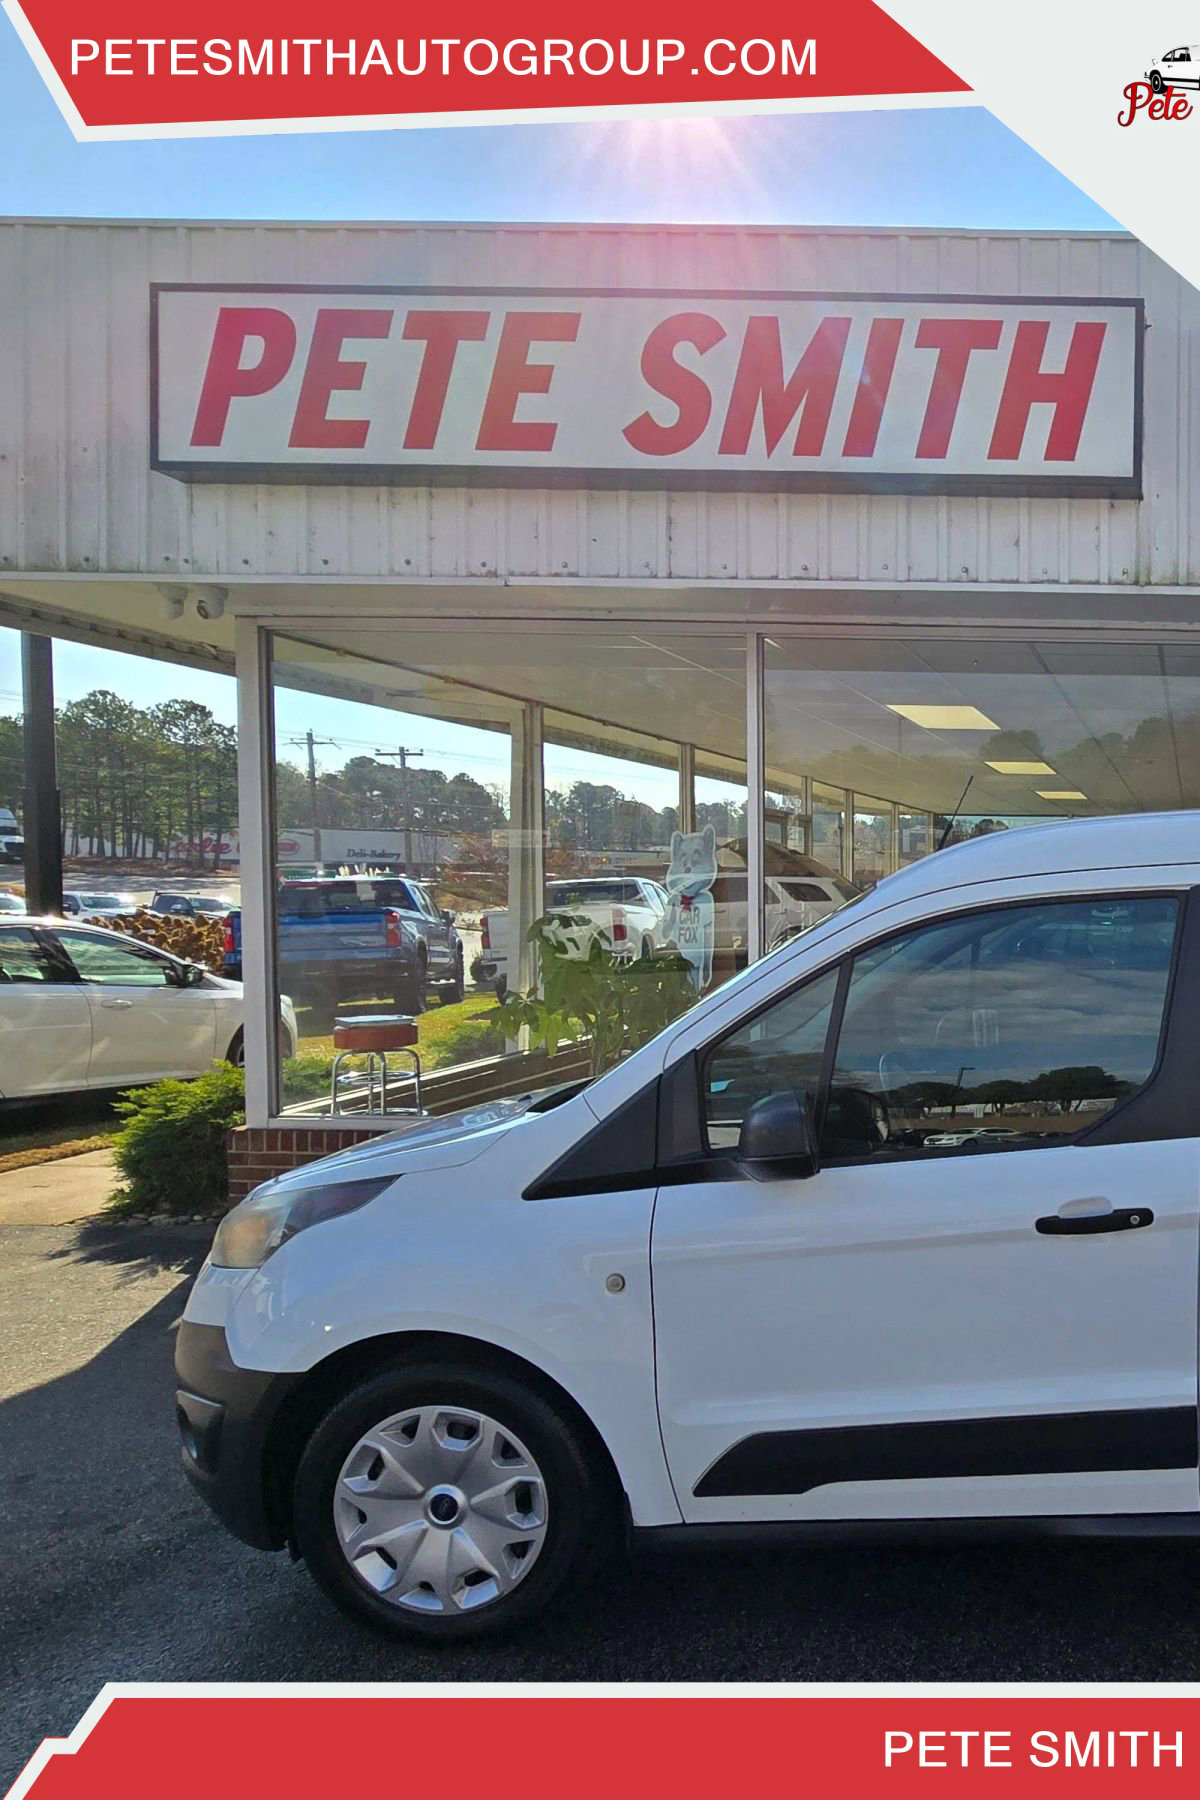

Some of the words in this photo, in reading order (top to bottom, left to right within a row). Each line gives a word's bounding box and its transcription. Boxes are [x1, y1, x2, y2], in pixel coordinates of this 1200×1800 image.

[189, 306, 582, 452] PETE
[621, 311, 1108, 462] SMITH
[678, 926, 699, 943] FOX
